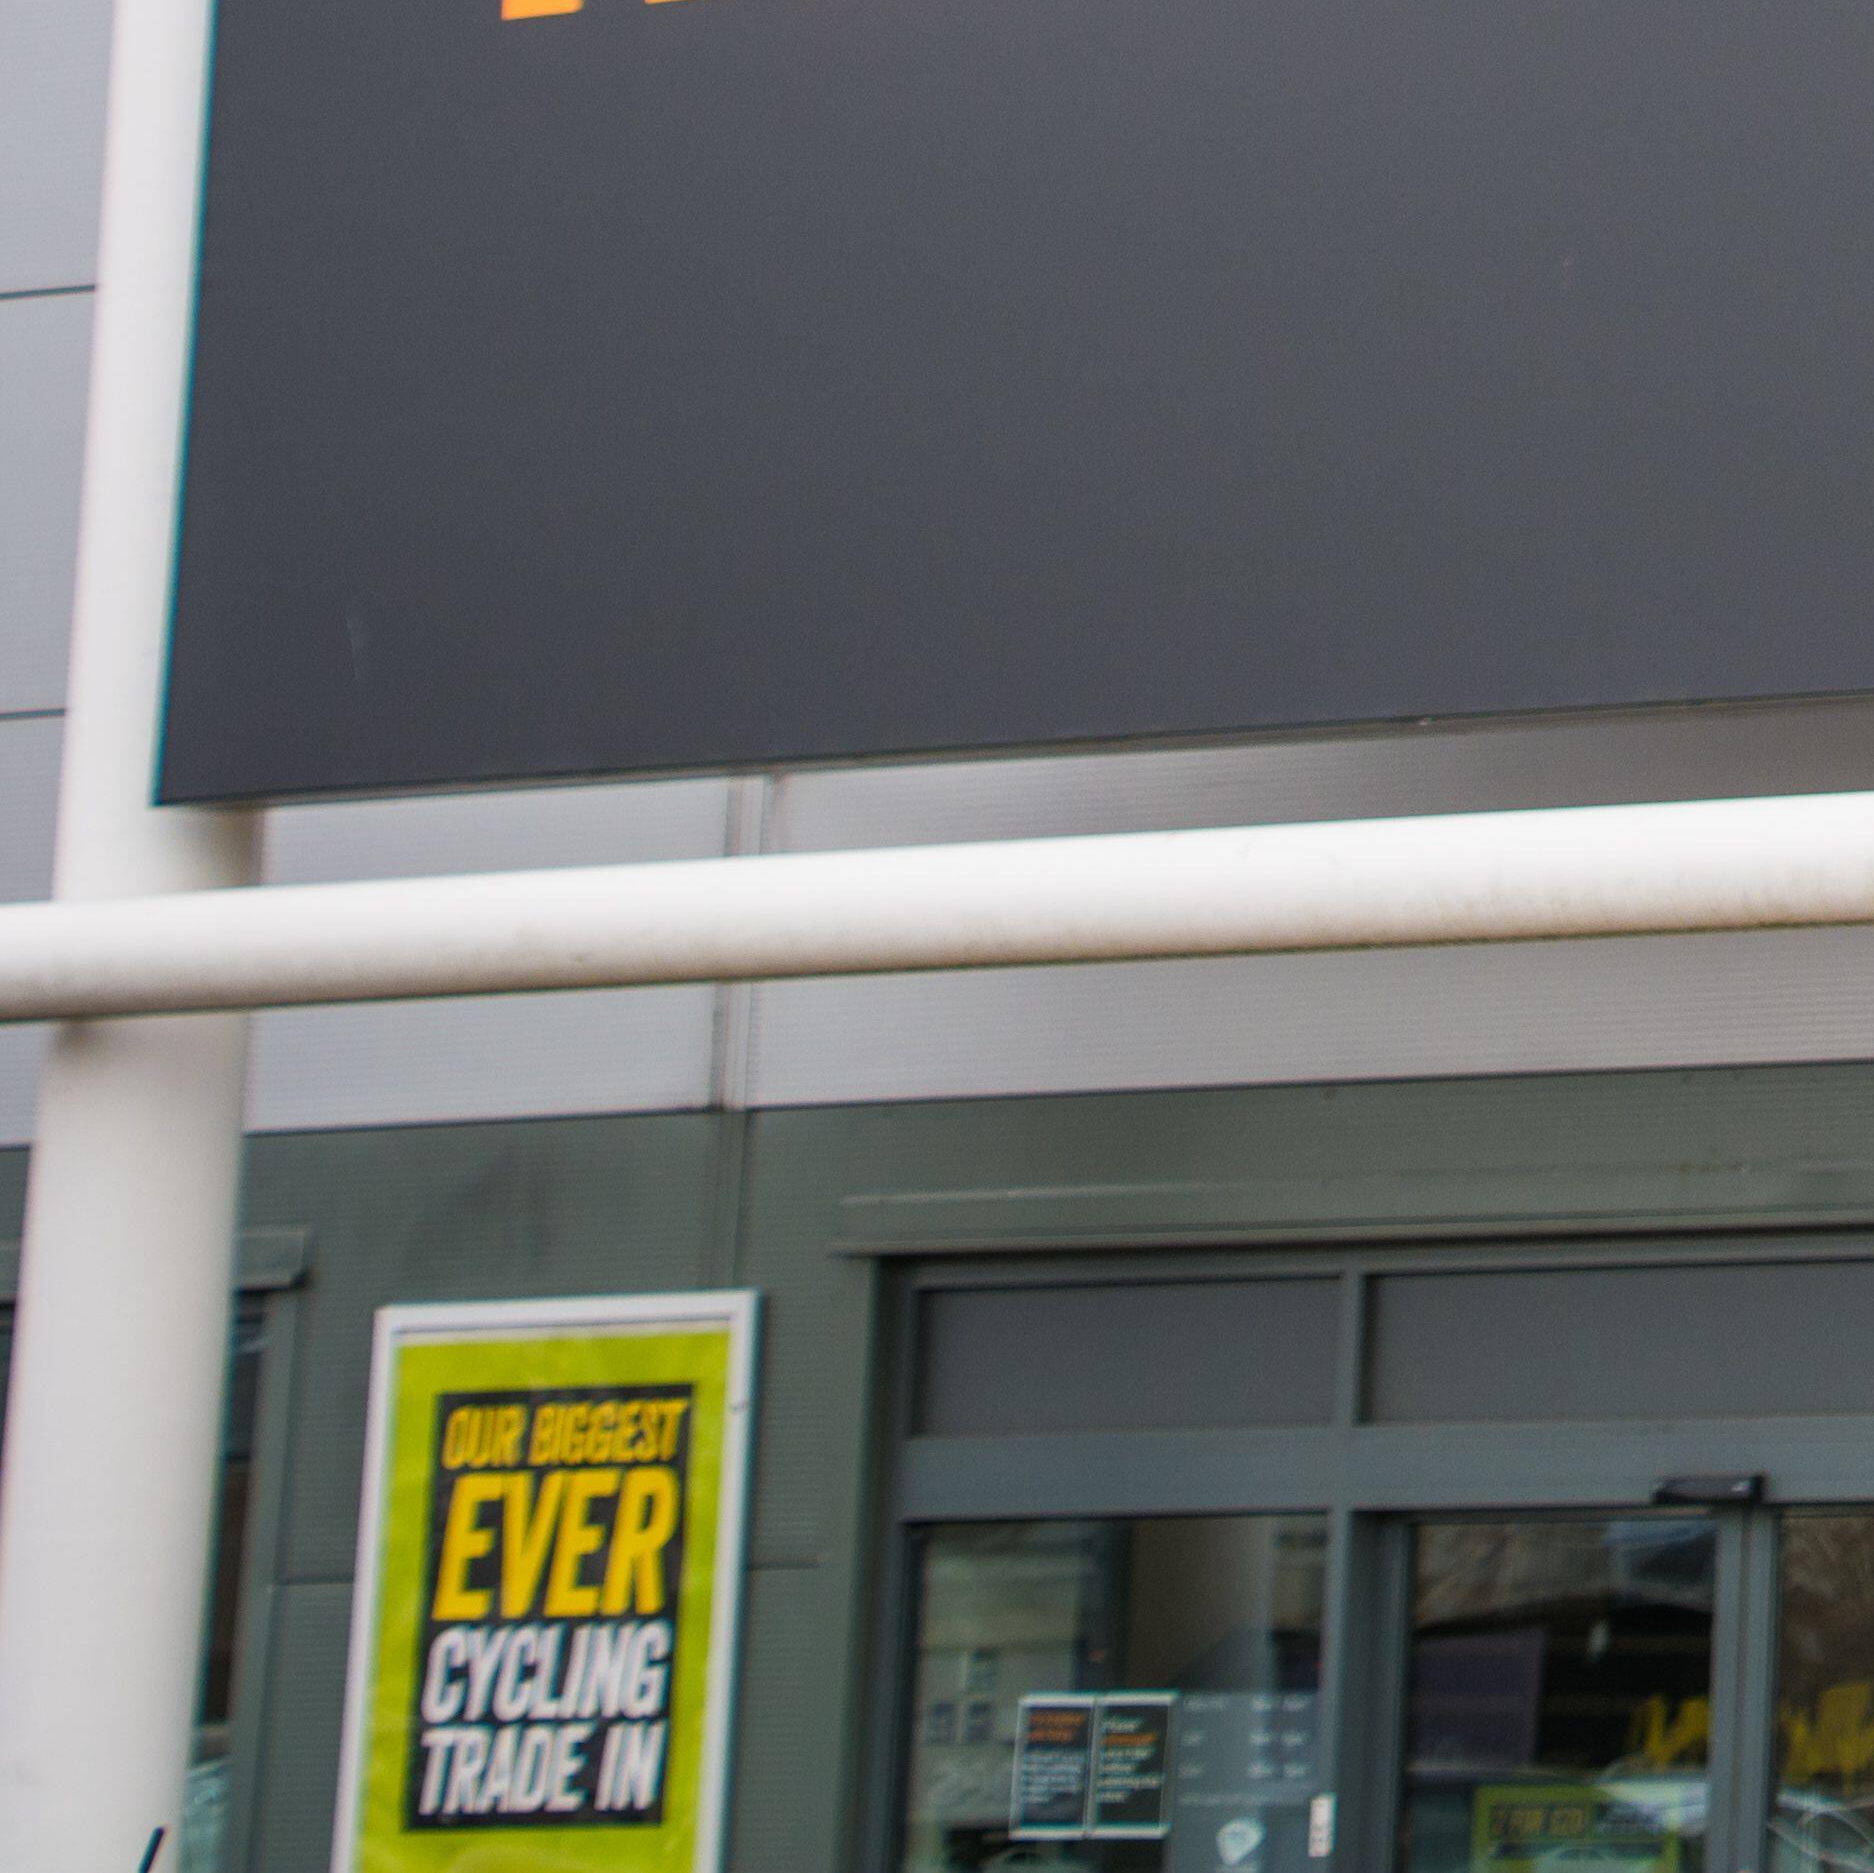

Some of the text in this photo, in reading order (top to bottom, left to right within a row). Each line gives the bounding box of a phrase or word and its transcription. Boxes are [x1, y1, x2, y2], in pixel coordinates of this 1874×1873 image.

[442, 1399, 690, 1469] OUR BIGGEST
[431, 1466, 680, 1621] EVER
[421, 1622, 674, 1724] CYCLING
[419, 1720, 667, 1816] TRADE IN
